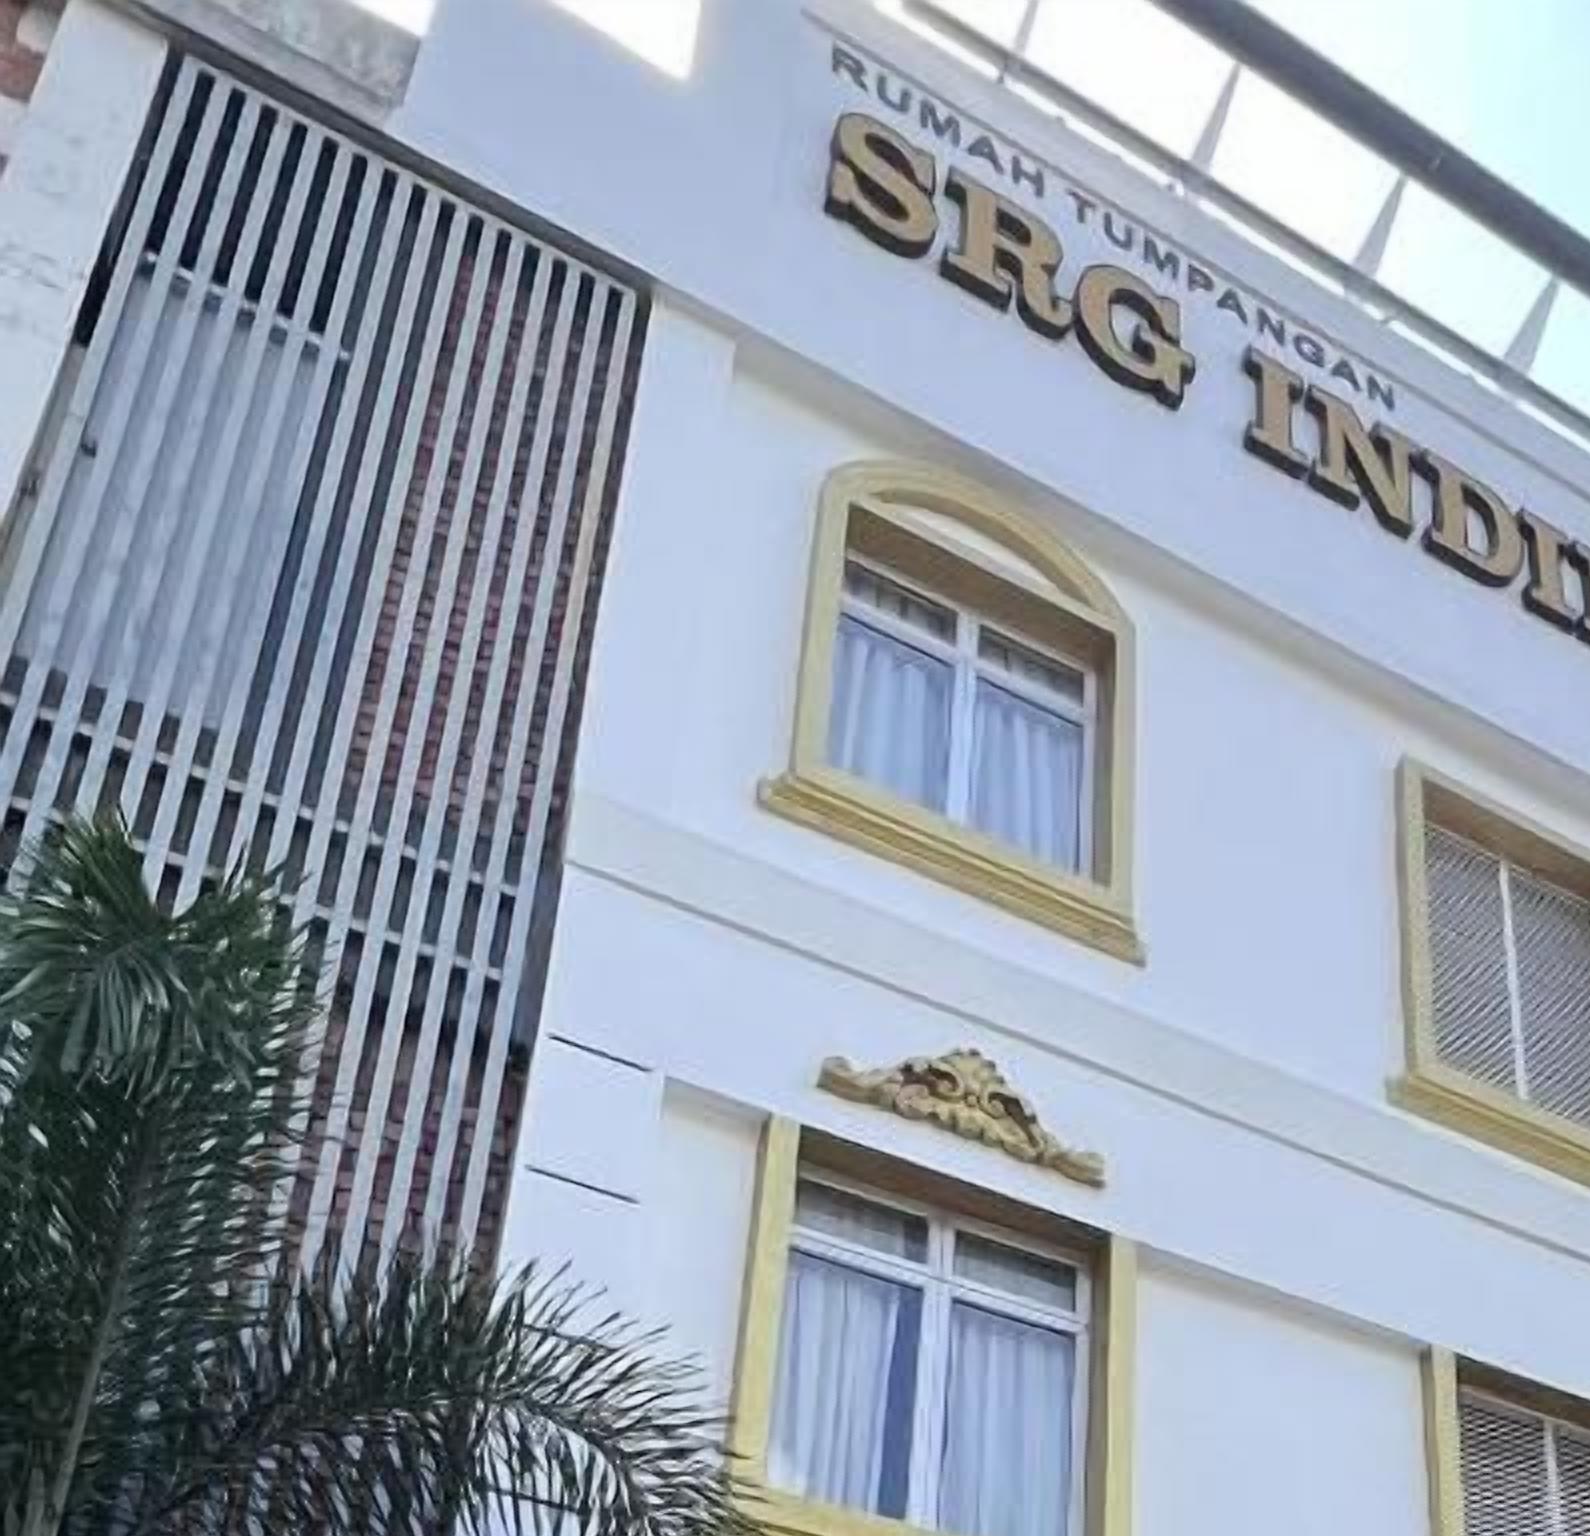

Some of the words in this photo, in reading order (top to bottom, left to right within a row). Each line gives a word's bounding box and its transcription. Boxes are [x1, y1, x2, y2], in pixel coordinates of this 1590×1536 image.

[824, 111, 1197, 412] SRG
[831, 43, 1045, 196] RUMAH
[1071, 193, 1397, 411] TUMPANGAN
